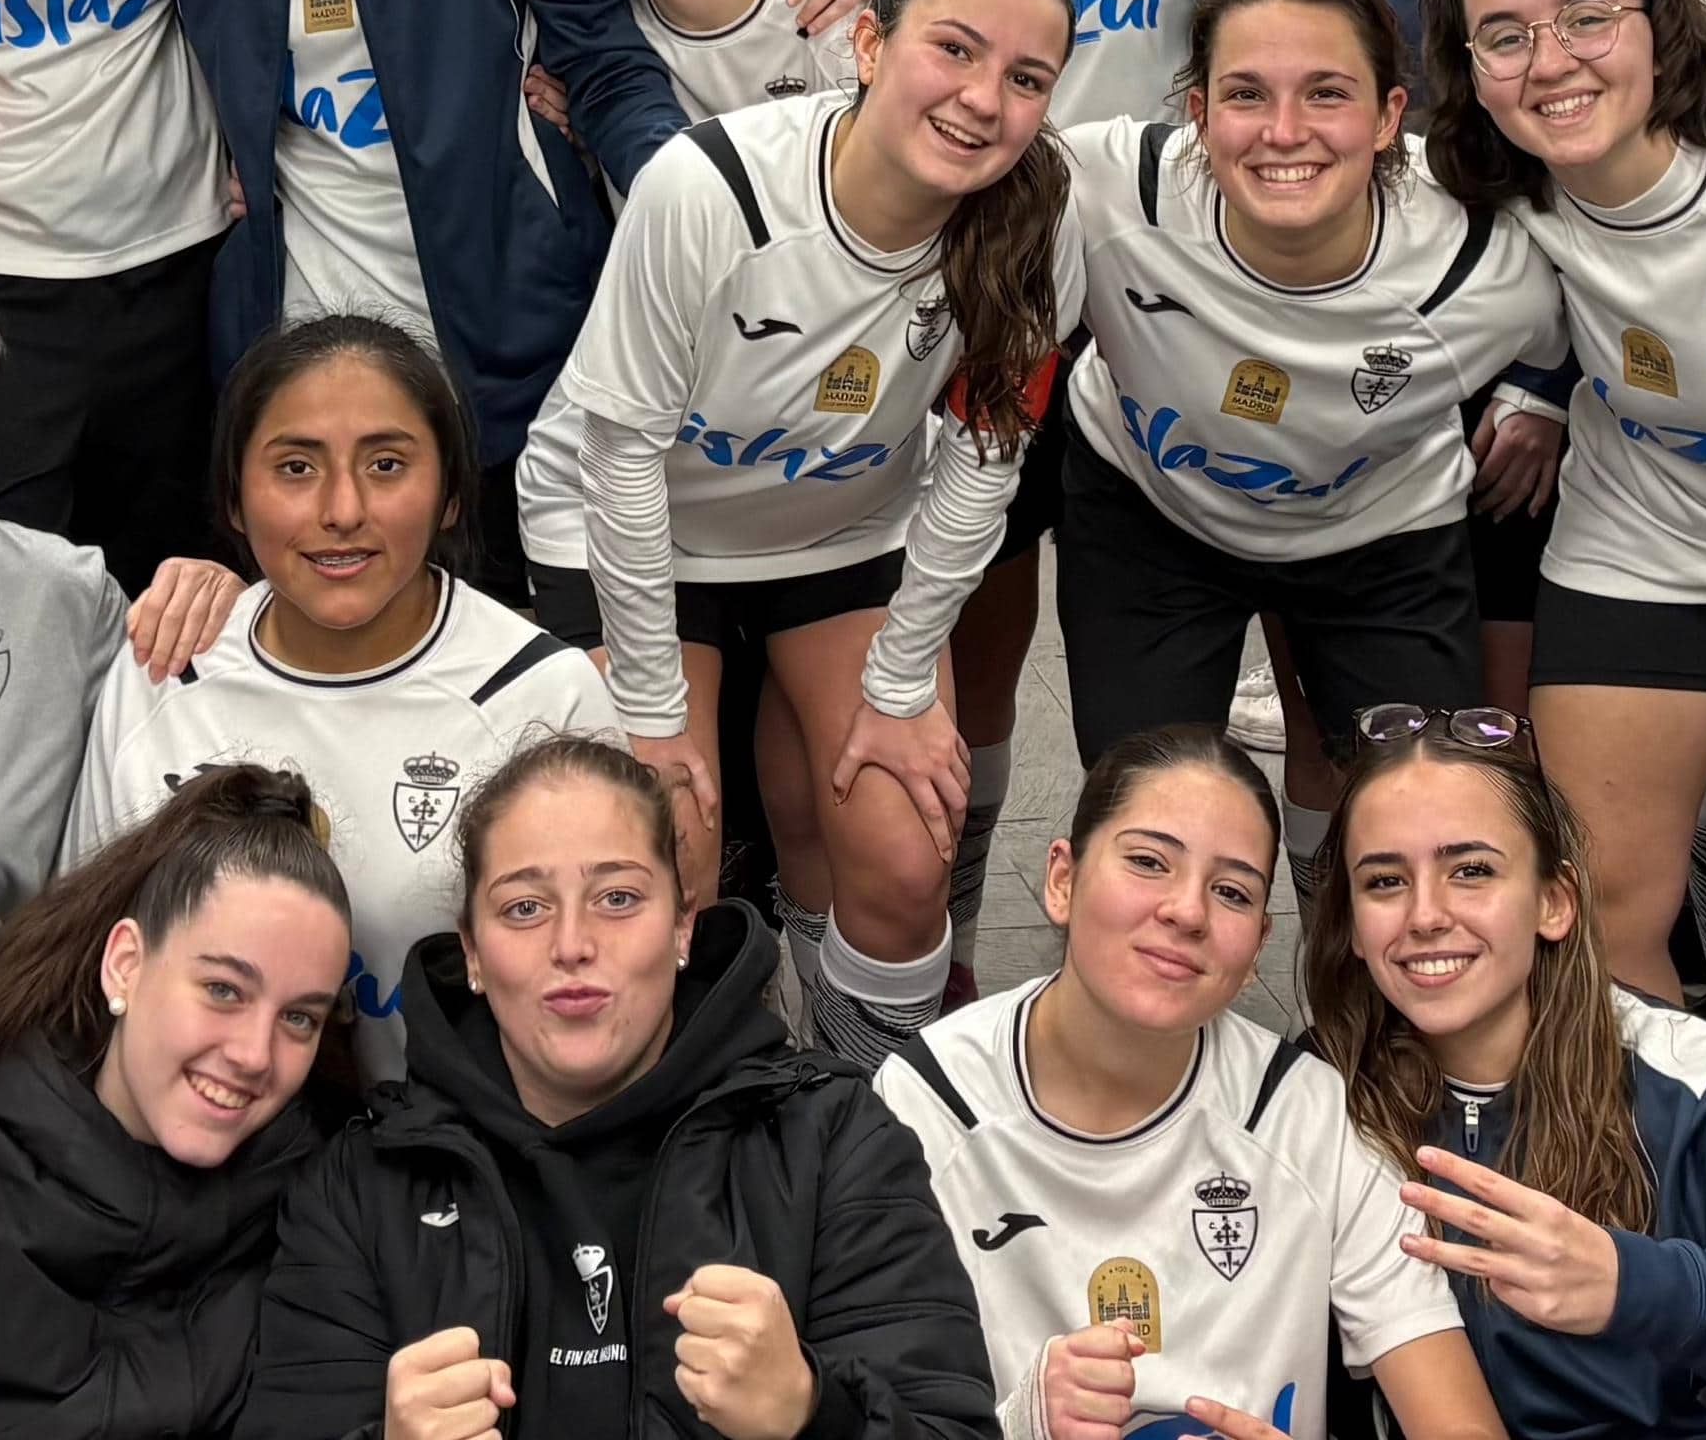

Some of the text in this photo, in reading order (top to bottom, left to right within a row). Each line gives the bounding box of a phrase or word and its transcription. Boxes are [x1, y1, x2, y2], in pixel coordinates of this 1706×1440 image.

[311, 7, 347, 19] MADRID
[823, 391, 867, 404] MADRID
[1232, 397, 1275, 413] MADRID
[550, 1346, 563, 1365] EL
[564, 1350, 583, 1366] FIN
